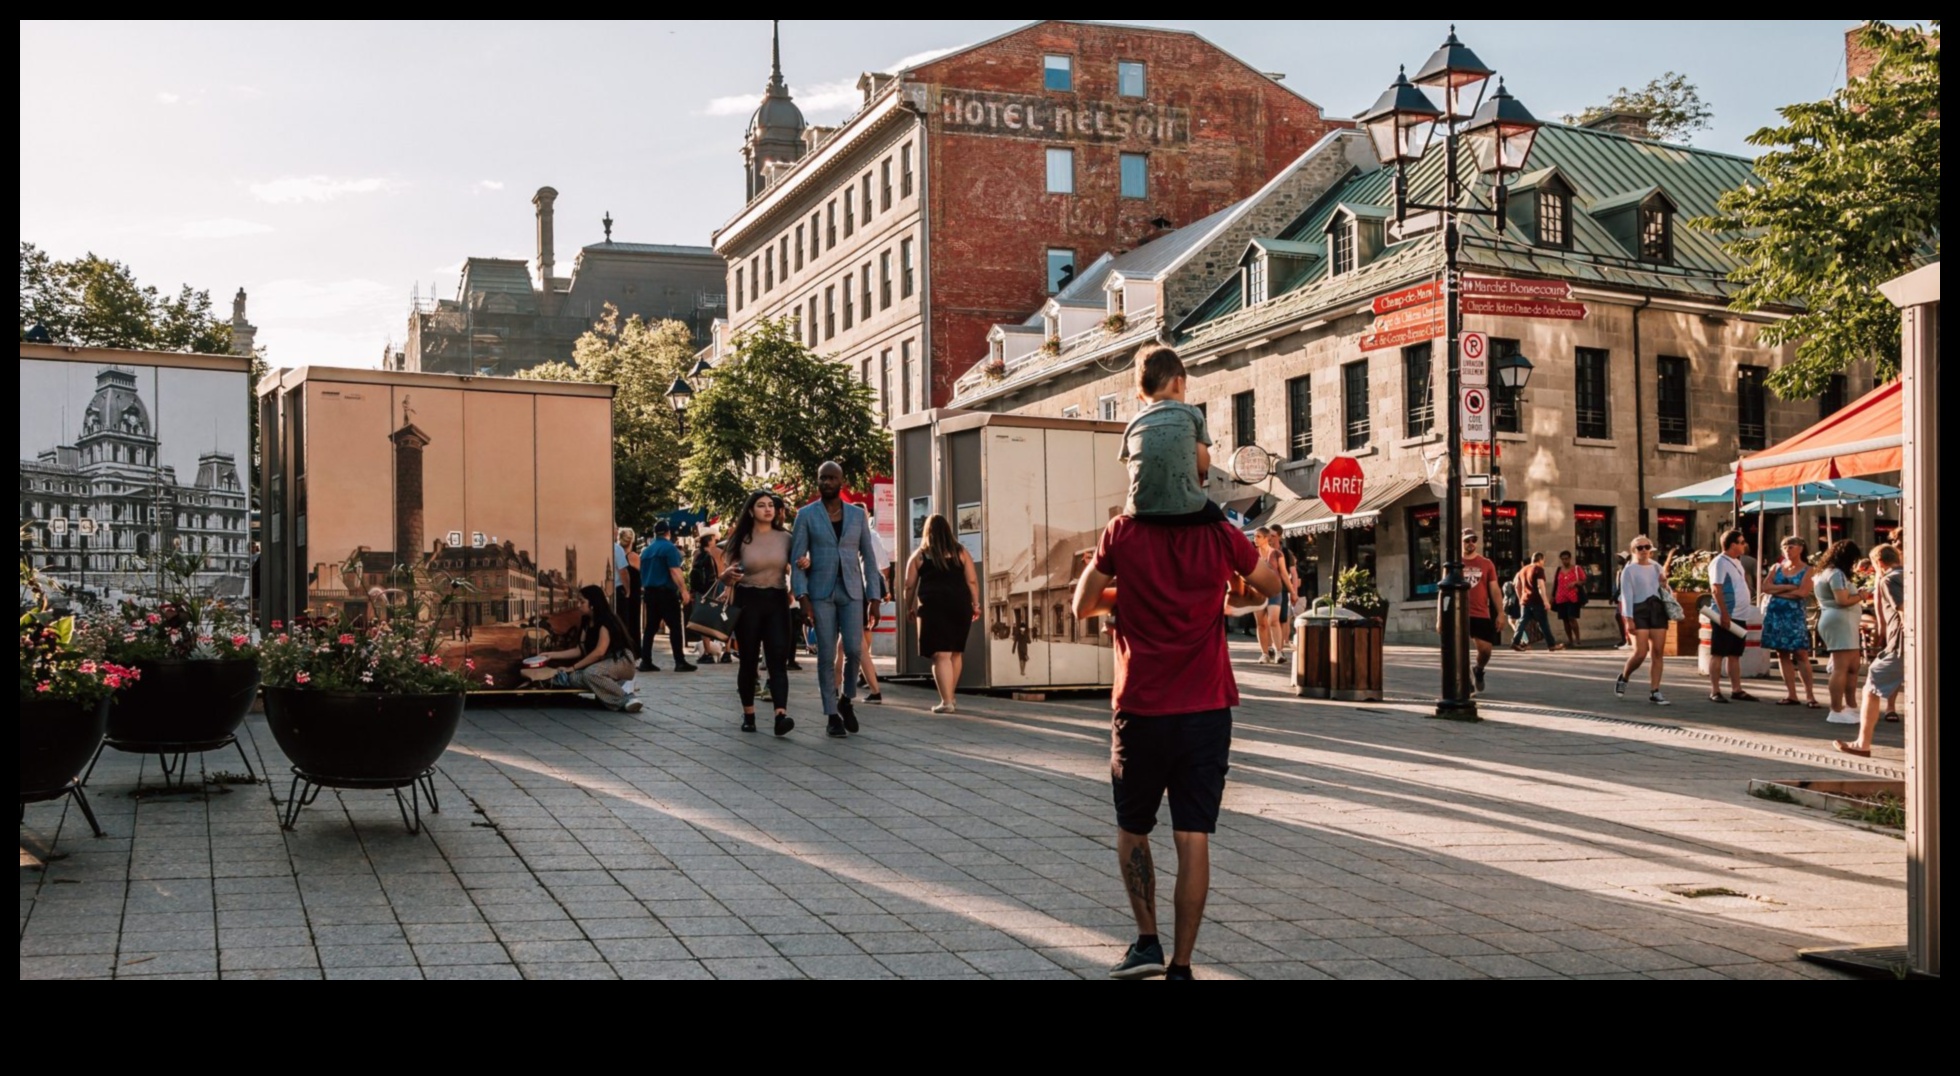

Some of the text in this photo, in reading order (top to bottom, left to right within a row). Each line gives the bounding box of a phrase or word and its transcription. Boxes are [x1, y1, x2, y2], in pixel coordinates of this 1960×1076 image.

[943, 98, 1044, 131] HOTEL
[1474, 281, 1566, 295] Marché Bonsecours
[1380, 288, 1433, 309] Champ-de-Mars
[1467, 300, 1495, 315] Chapelle
[1467, 423, 1483, 431] DROIT
[1321, 475, 1363, 495] ARRÊT
